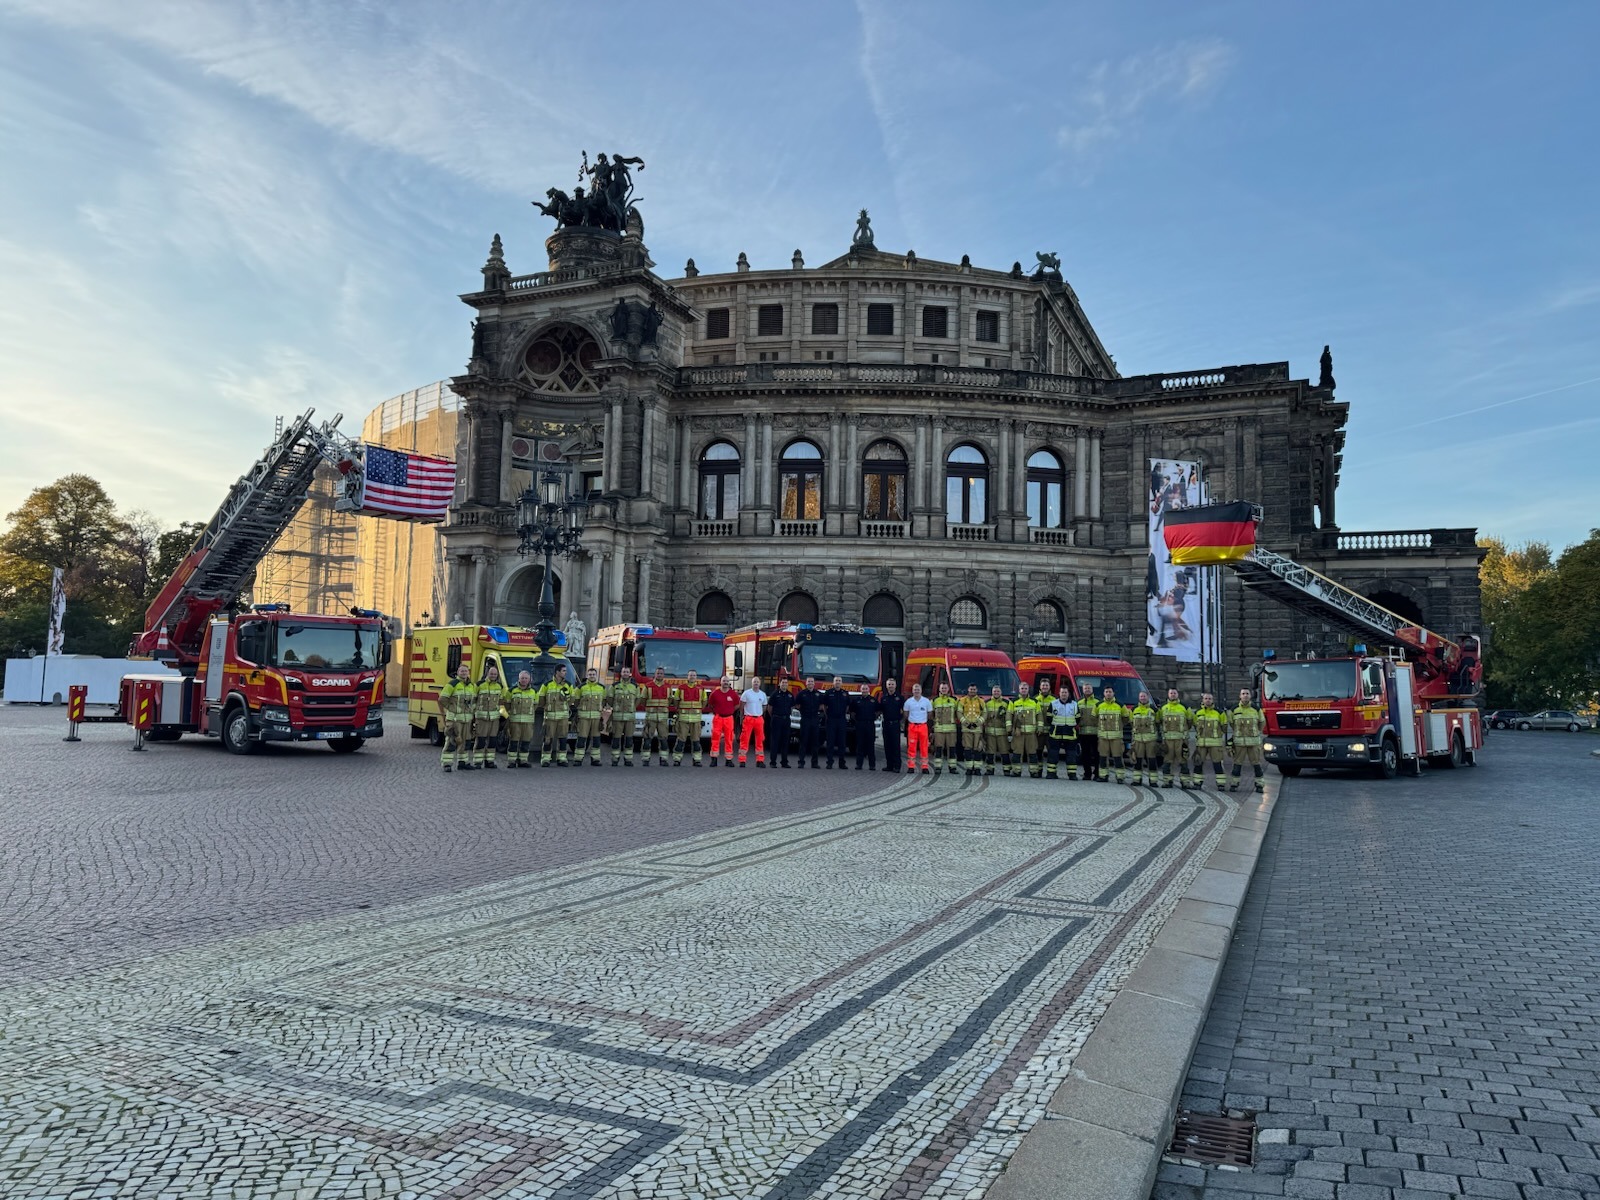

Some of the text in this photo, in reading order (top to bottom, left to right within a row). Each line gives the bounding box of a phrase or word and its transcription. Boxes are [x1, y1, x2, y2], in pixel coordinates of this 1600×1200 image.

[806, 633, 812, 641] 5
[312, 678, 351, 686] SCANIA
[1284, 702, 1331, 710] FEUERWEHR
